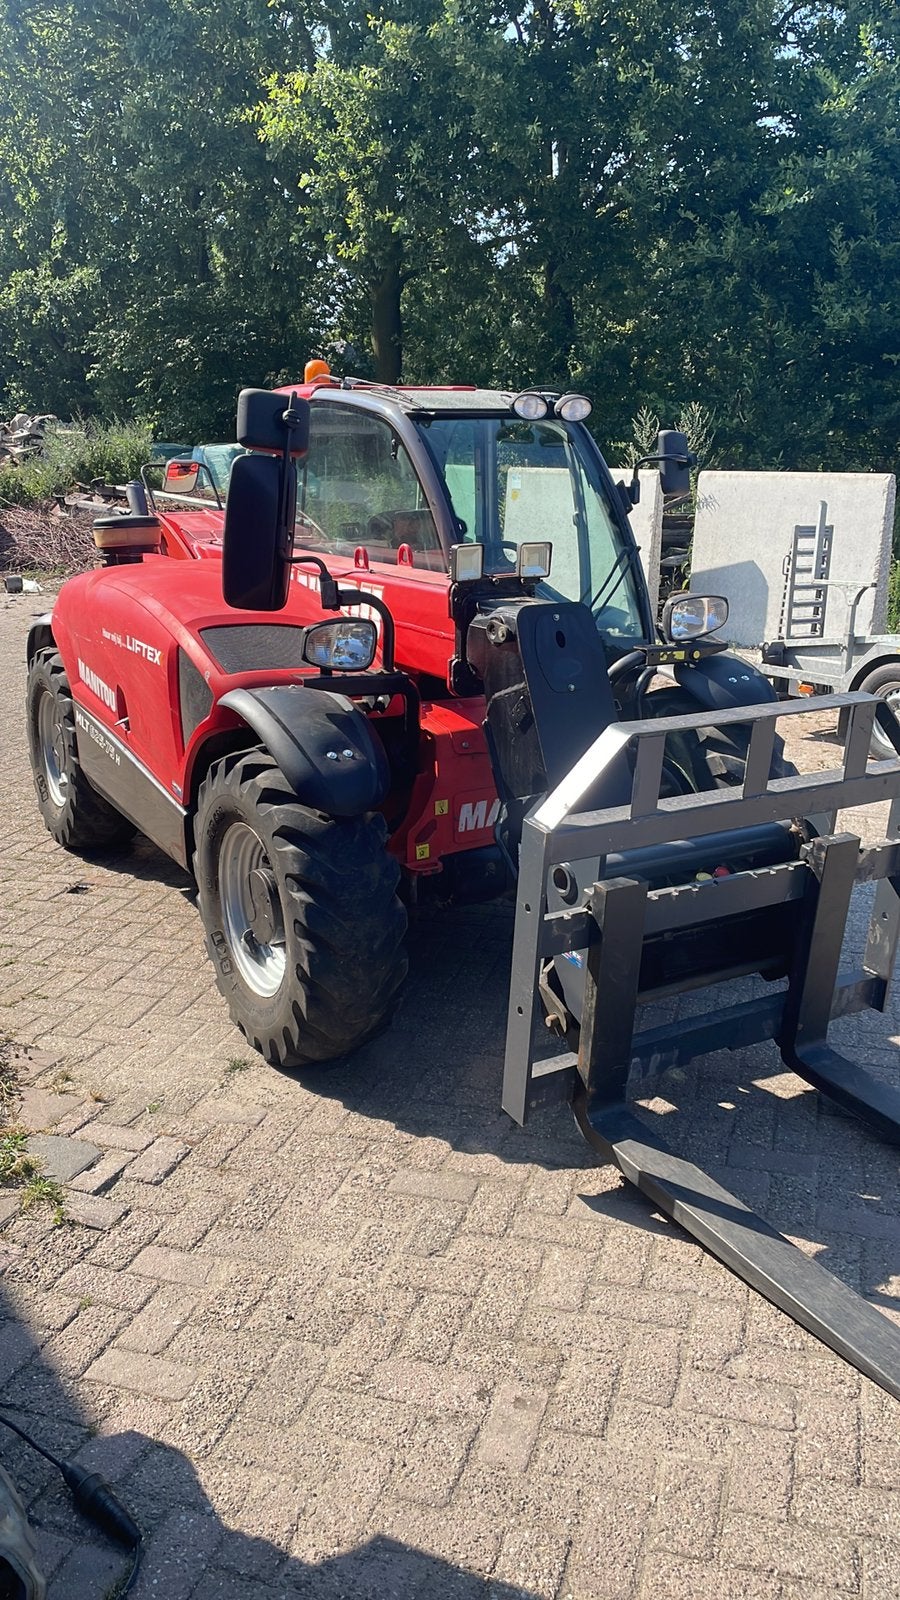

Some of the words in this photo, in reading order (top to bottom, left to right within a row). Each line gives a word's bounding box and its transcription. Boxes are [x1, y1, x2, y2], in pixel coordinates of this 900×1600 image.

[126, 635, 162, 666] LIFTEX
[78, 657, 117, 713] MANITOU
[75, 710, 90, 733] MLT
[210, 930, 233, 976] BKT
